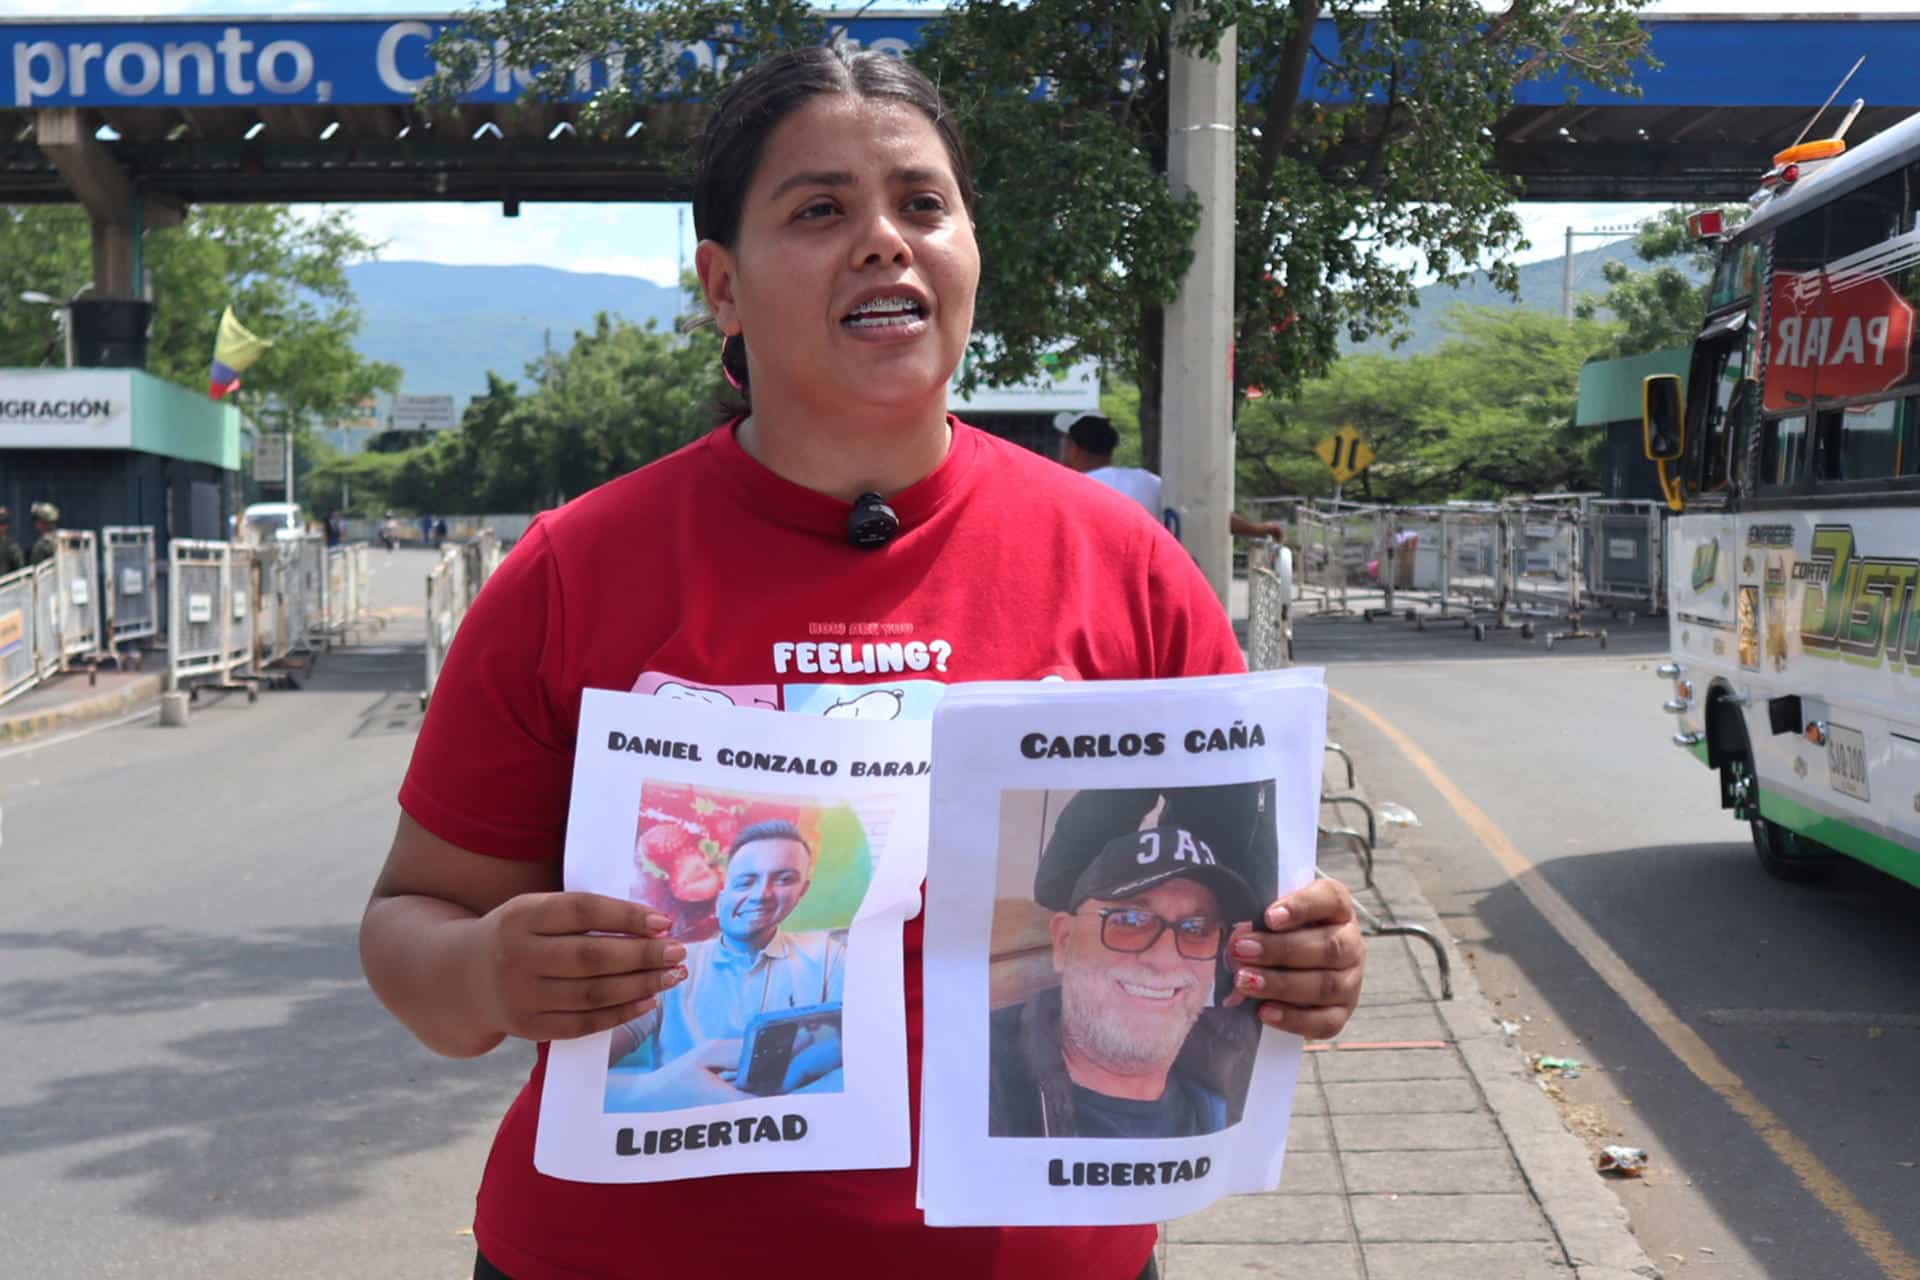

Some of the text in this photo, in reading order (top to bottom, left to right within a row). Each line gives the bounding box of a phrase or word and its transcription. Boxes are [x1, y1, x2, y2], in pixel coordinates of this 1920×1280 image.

[14, 27, 332, 106] pronto,
[773, 640, 952, 674] FEELING?
[608, 731, 702, 762] DANIEL
[717, 748, 837, 775] GONZALO
[1020, 720, 1265, 759] CARLOS CAÑA
[616, 1114, 808, 1156] LIBERTAD
[1048, 1156, 1211, 1186] LIBERTAD
